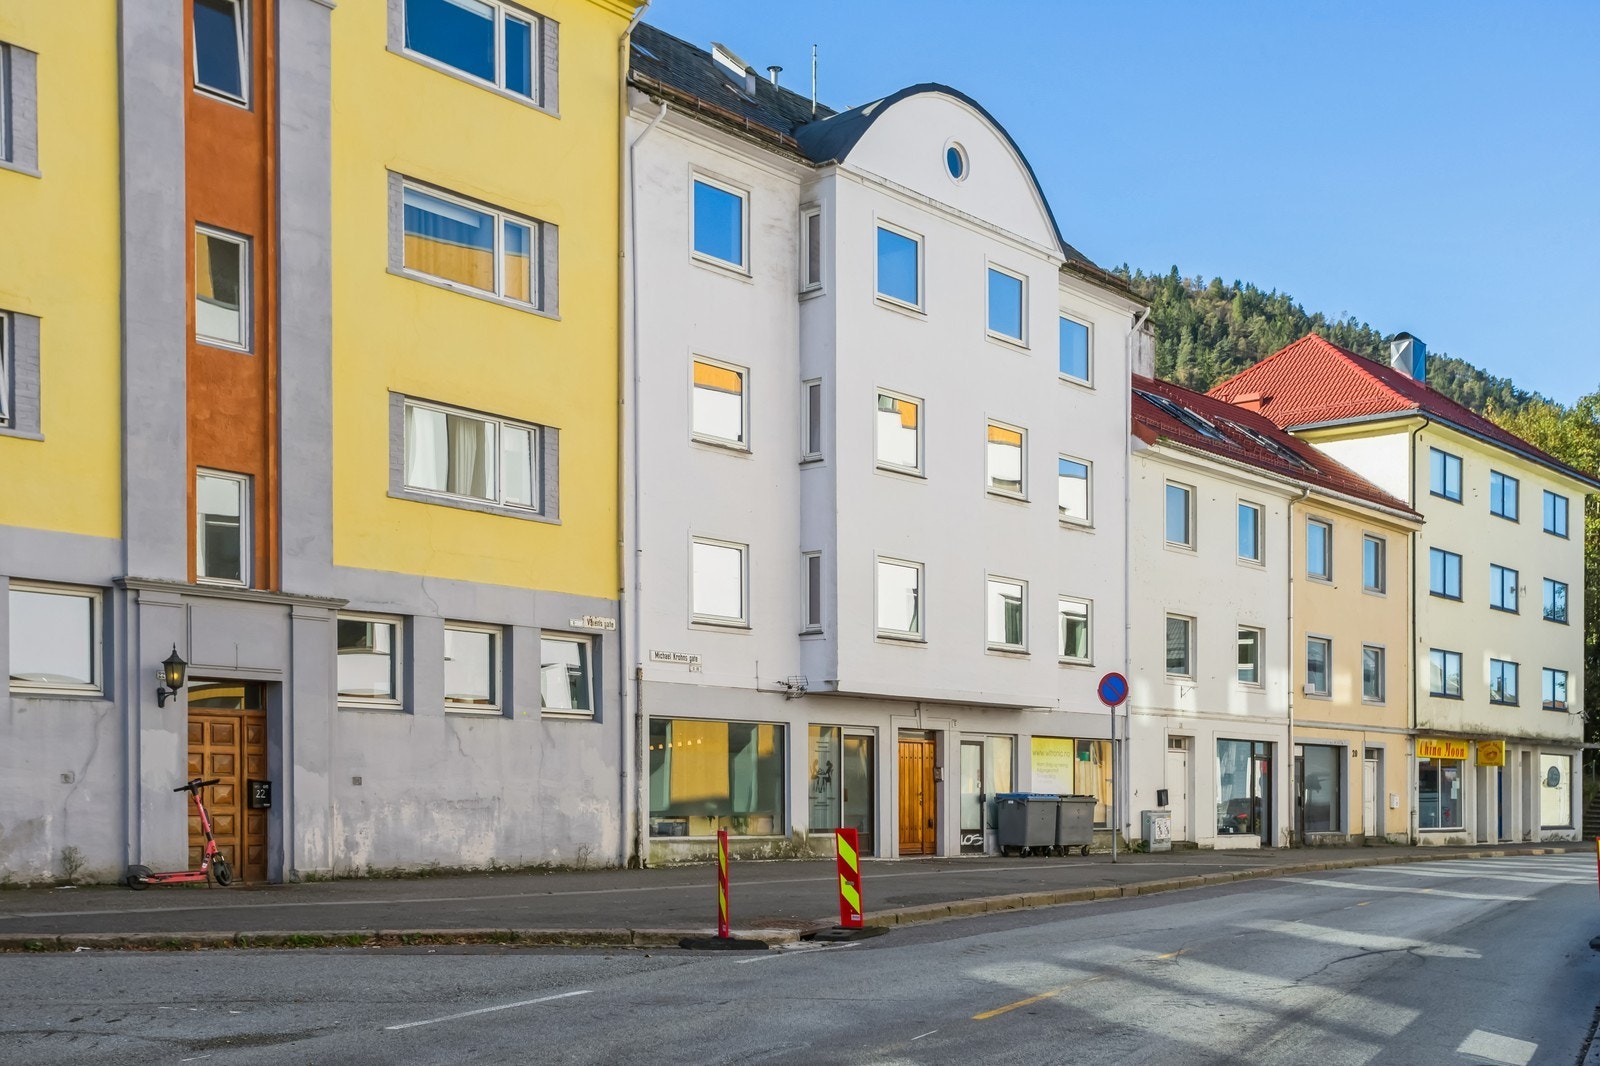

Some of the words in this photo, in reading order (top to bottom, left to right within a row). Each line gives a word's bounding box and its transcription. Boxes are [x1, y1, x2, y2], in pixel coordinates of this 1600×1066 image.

[604, 621, 614, 630] gate
[655, 651, 671, 660] Michael
[673, 653, 688, 662] Krohns
[689, 655, 698, 663] gate
[1420, 741, 1442, 757] China
[1444, 742, 1465, 758] Moon
[256, 789, 266, 799] 22
